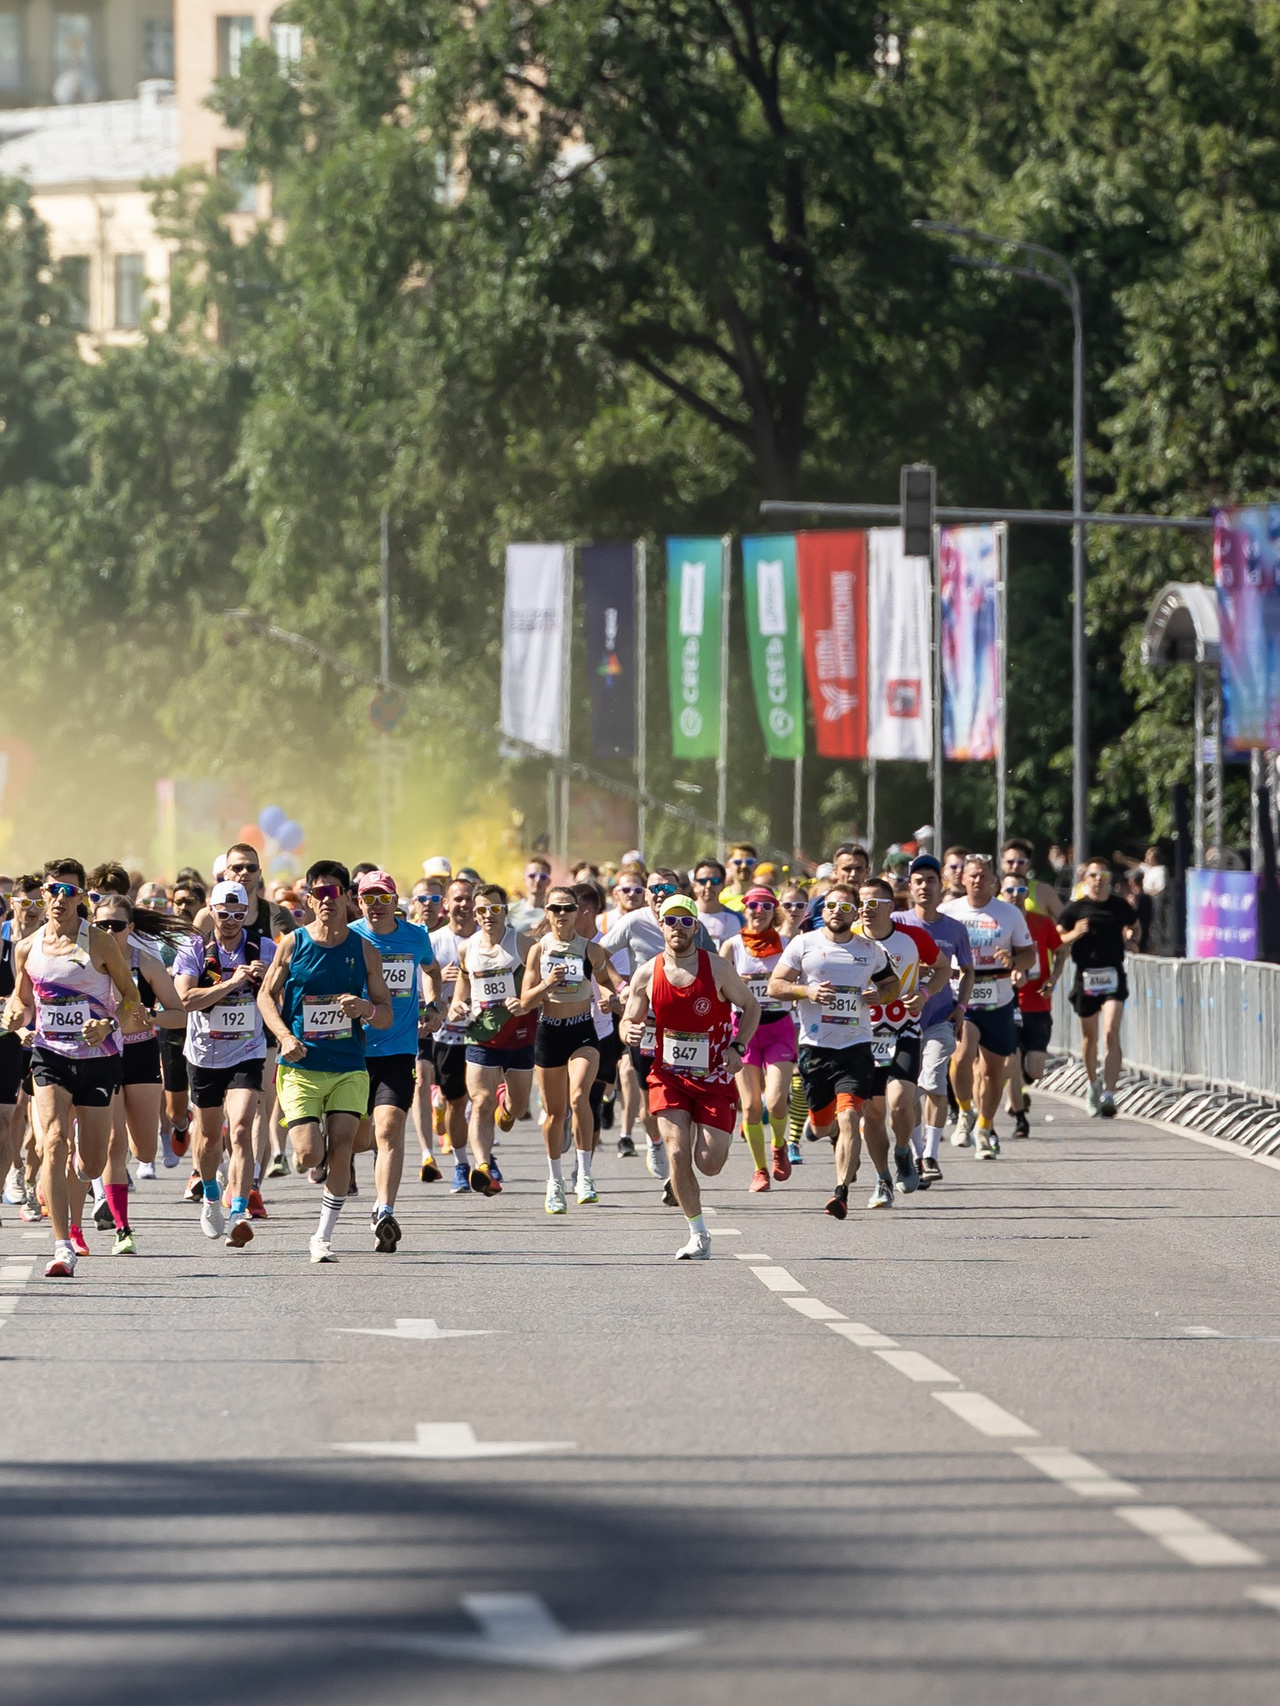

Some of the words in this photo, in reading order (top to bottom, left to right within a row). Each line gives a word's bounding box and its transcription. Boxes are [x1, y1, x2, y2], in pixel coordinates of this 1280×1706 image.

[483, 981, 507, 995] 883
[970, 988, 993, 1000] 859
[829, 998, 858, 1012] 5814
[47, 1010, 84, 1026] 7848
[221, 1011, 246, 1026] 192
[310, 1009, 346, 1025] 4279
[565, 1010, 591, 1027] NIKE
[122, 1031, 148, 1043] NIKE
[672, 1045, 698, 1061] 847
